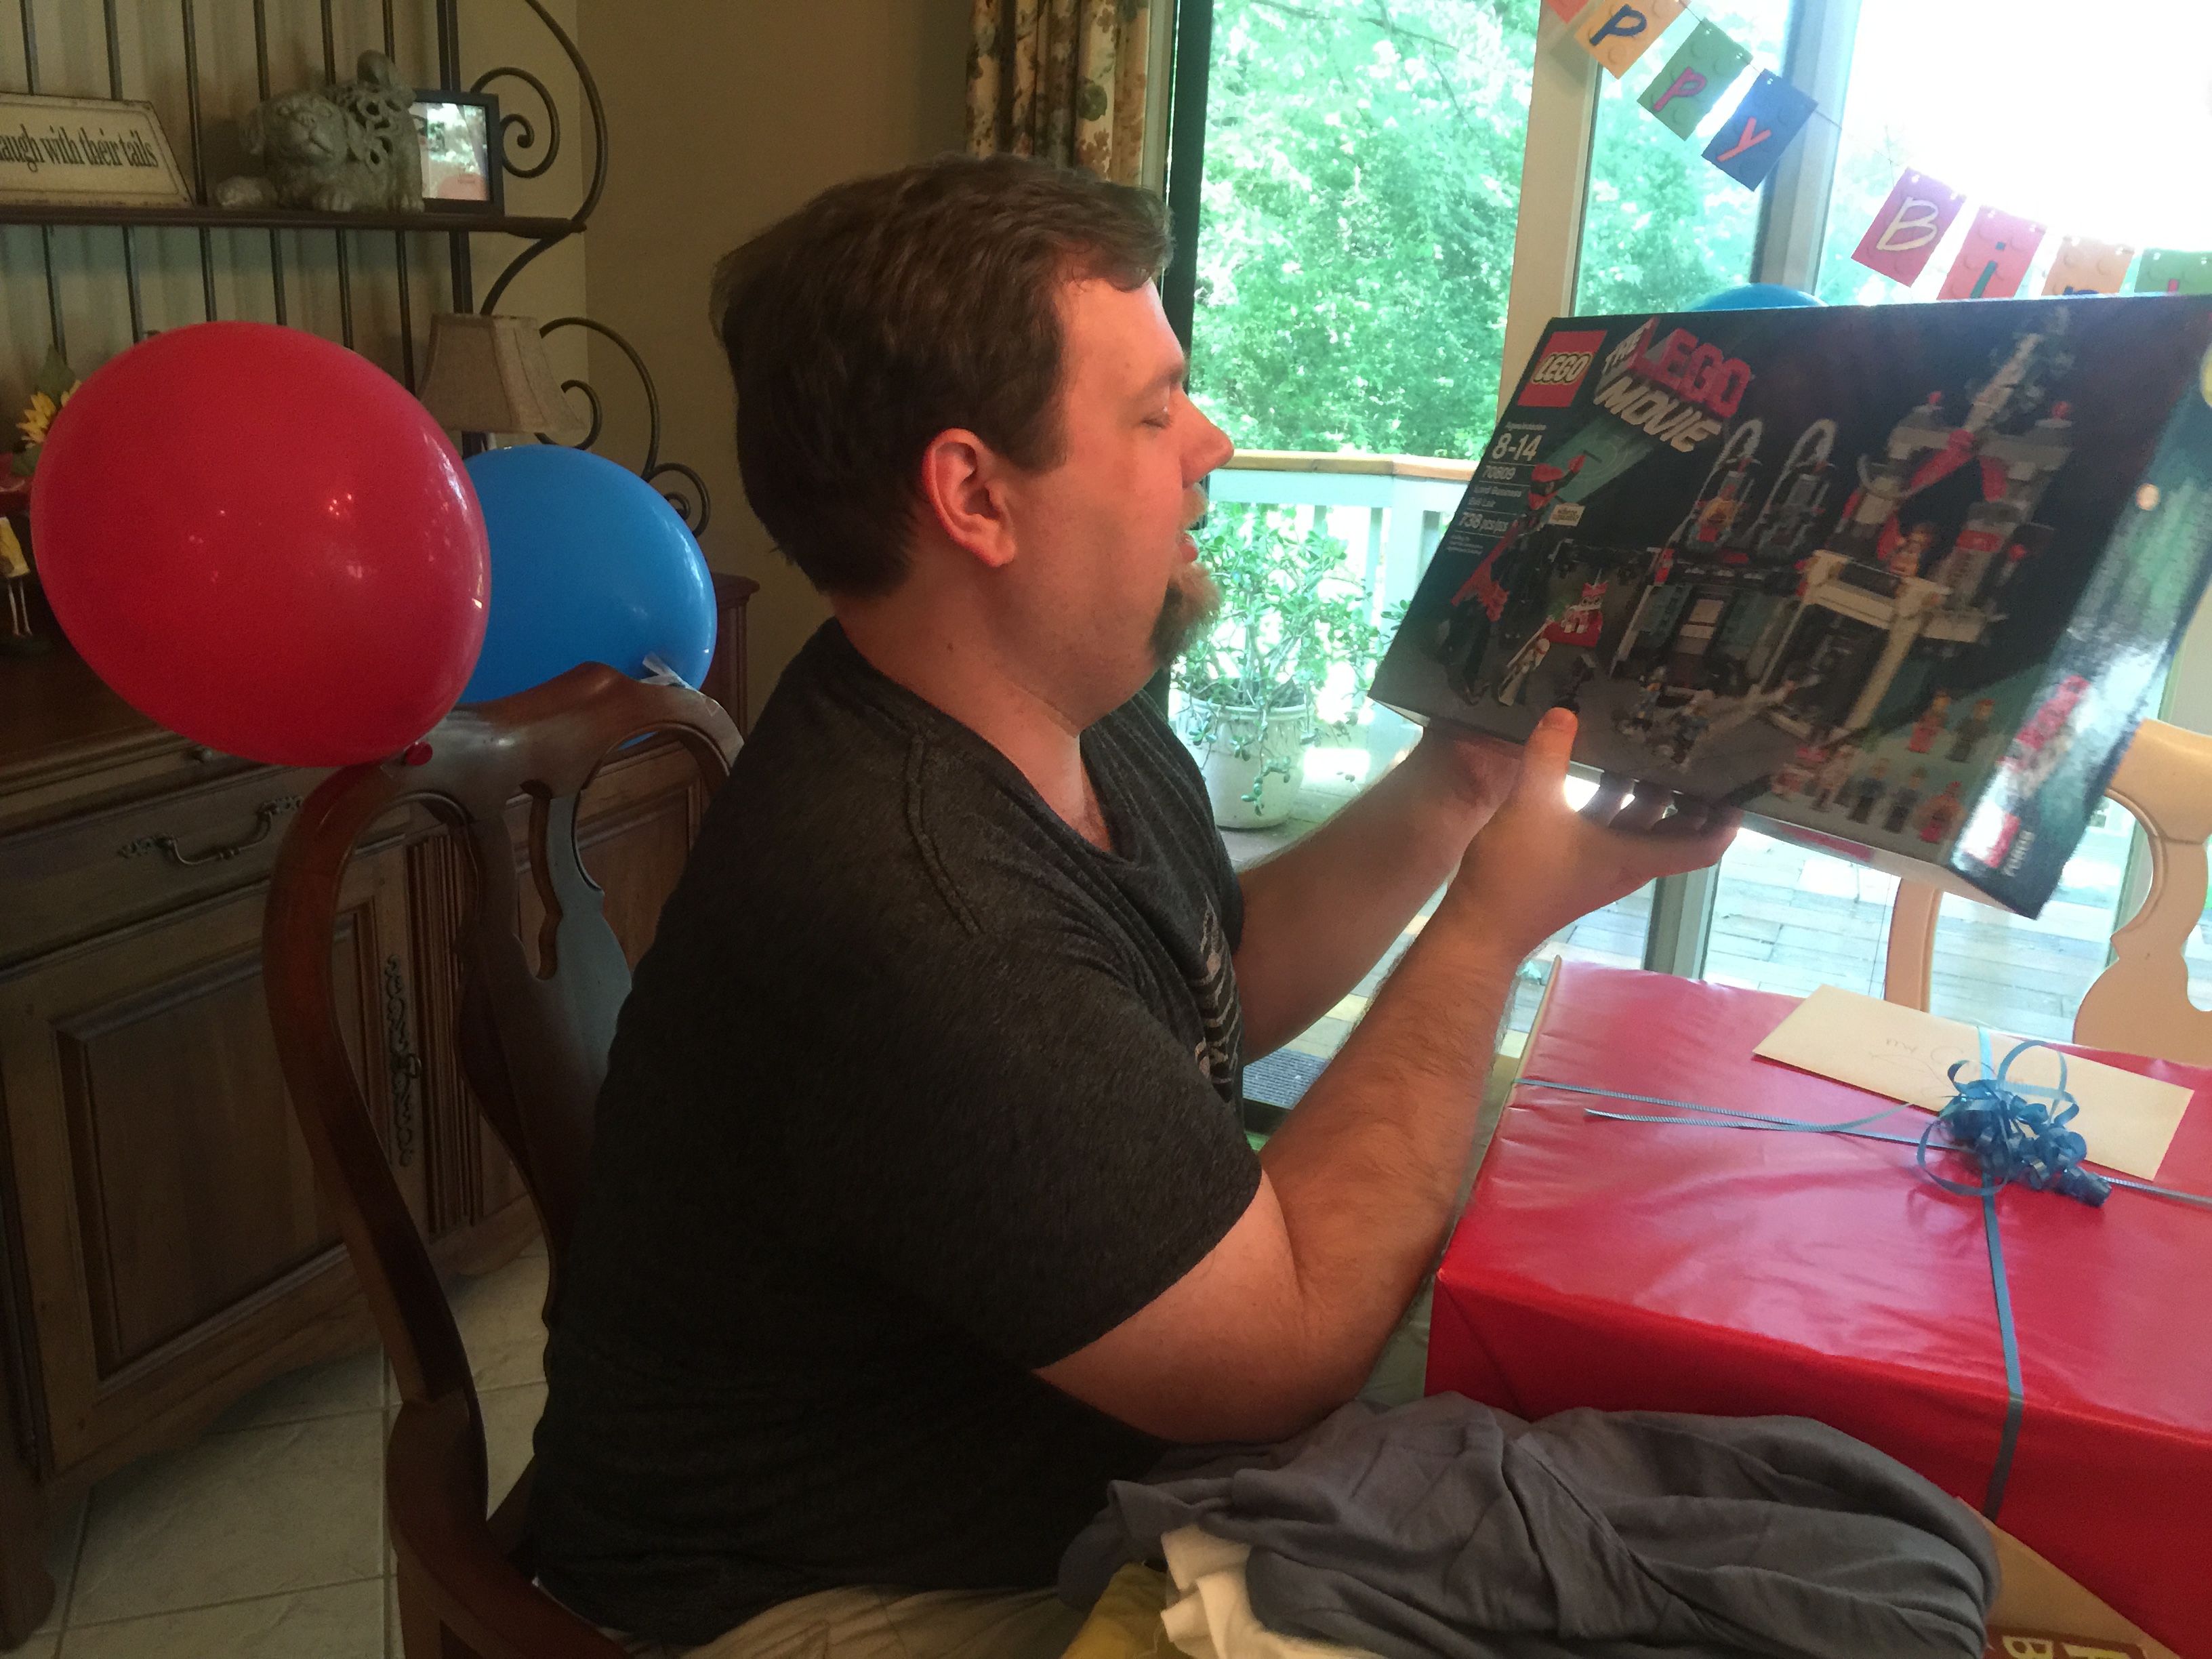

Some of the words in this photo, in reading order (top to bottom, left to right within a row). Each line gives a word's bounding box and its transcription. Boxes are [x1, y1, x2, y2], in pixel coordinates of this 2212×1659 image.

[0, 123, 45, 173] augh
[39, 125, 85, 164] with
[78, 127, 123, 166] their
[117, 129, 159, 168] tails
[1532, 352, 1593, 385] LEGO
[1626, 317, 1751, 418] LEGO
[1593, 375, 1721, 452] MOVIE
[1492, 433, 1543, 461] 8-14
